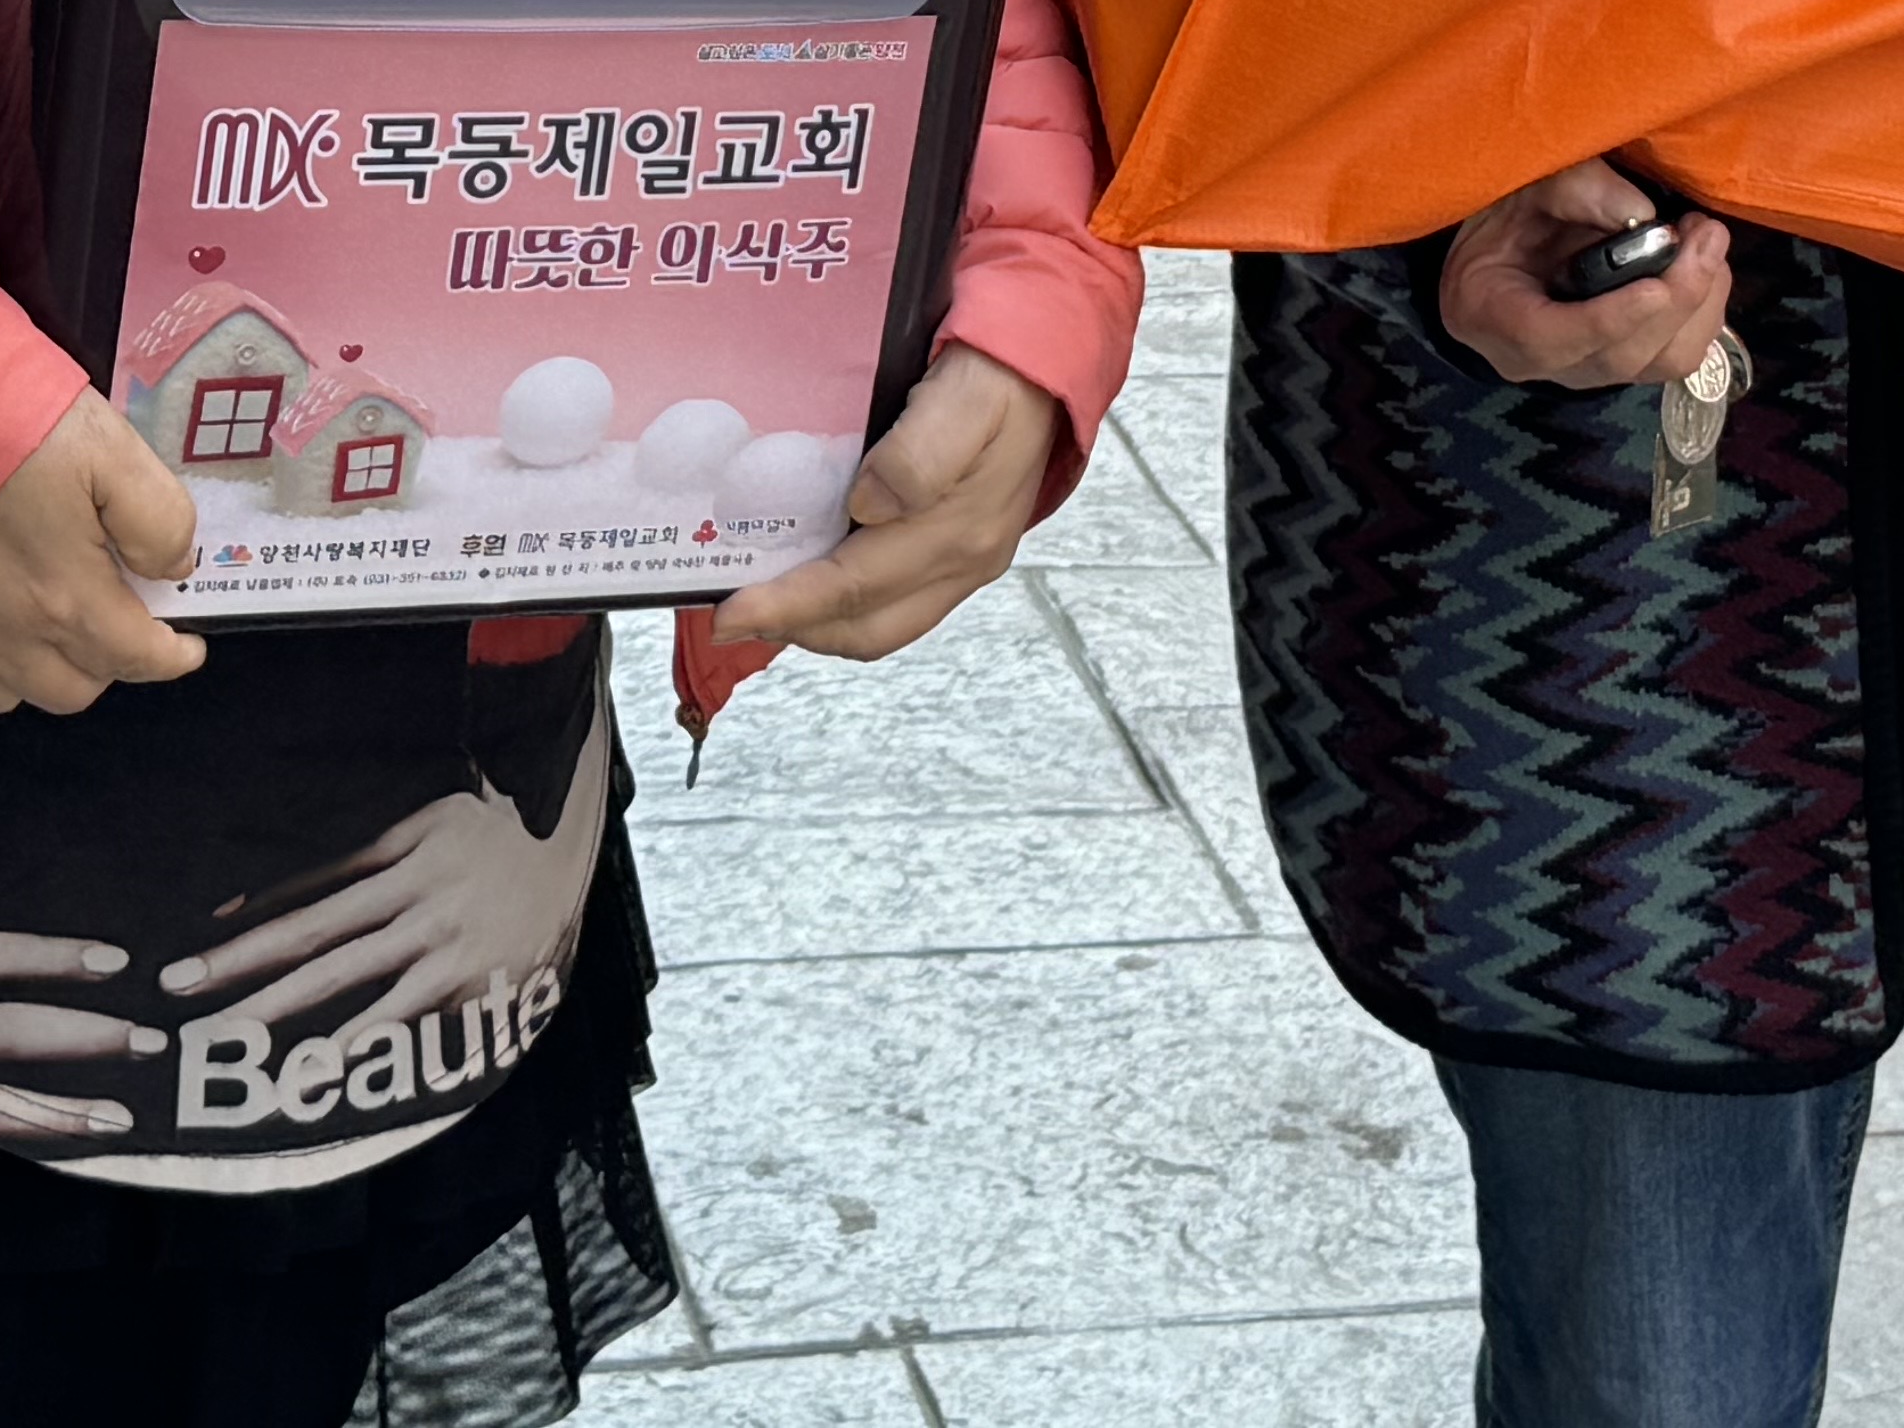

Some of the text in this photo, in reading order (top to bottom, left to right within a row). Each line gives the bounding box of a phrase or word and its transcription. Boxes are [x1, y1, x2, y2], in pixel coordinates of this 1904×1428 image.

[356, 107, 872, 202] 목동제일교회
[449, 219, 850, 290] 따뜻한 의식주
[259, 538, 431, 564] 양천사랑복지재단
[460, 533, 507, 558] 후원
[558, 525, 679, 551] 목동제일교회
[177, 966, 563, 1128] Beaute
